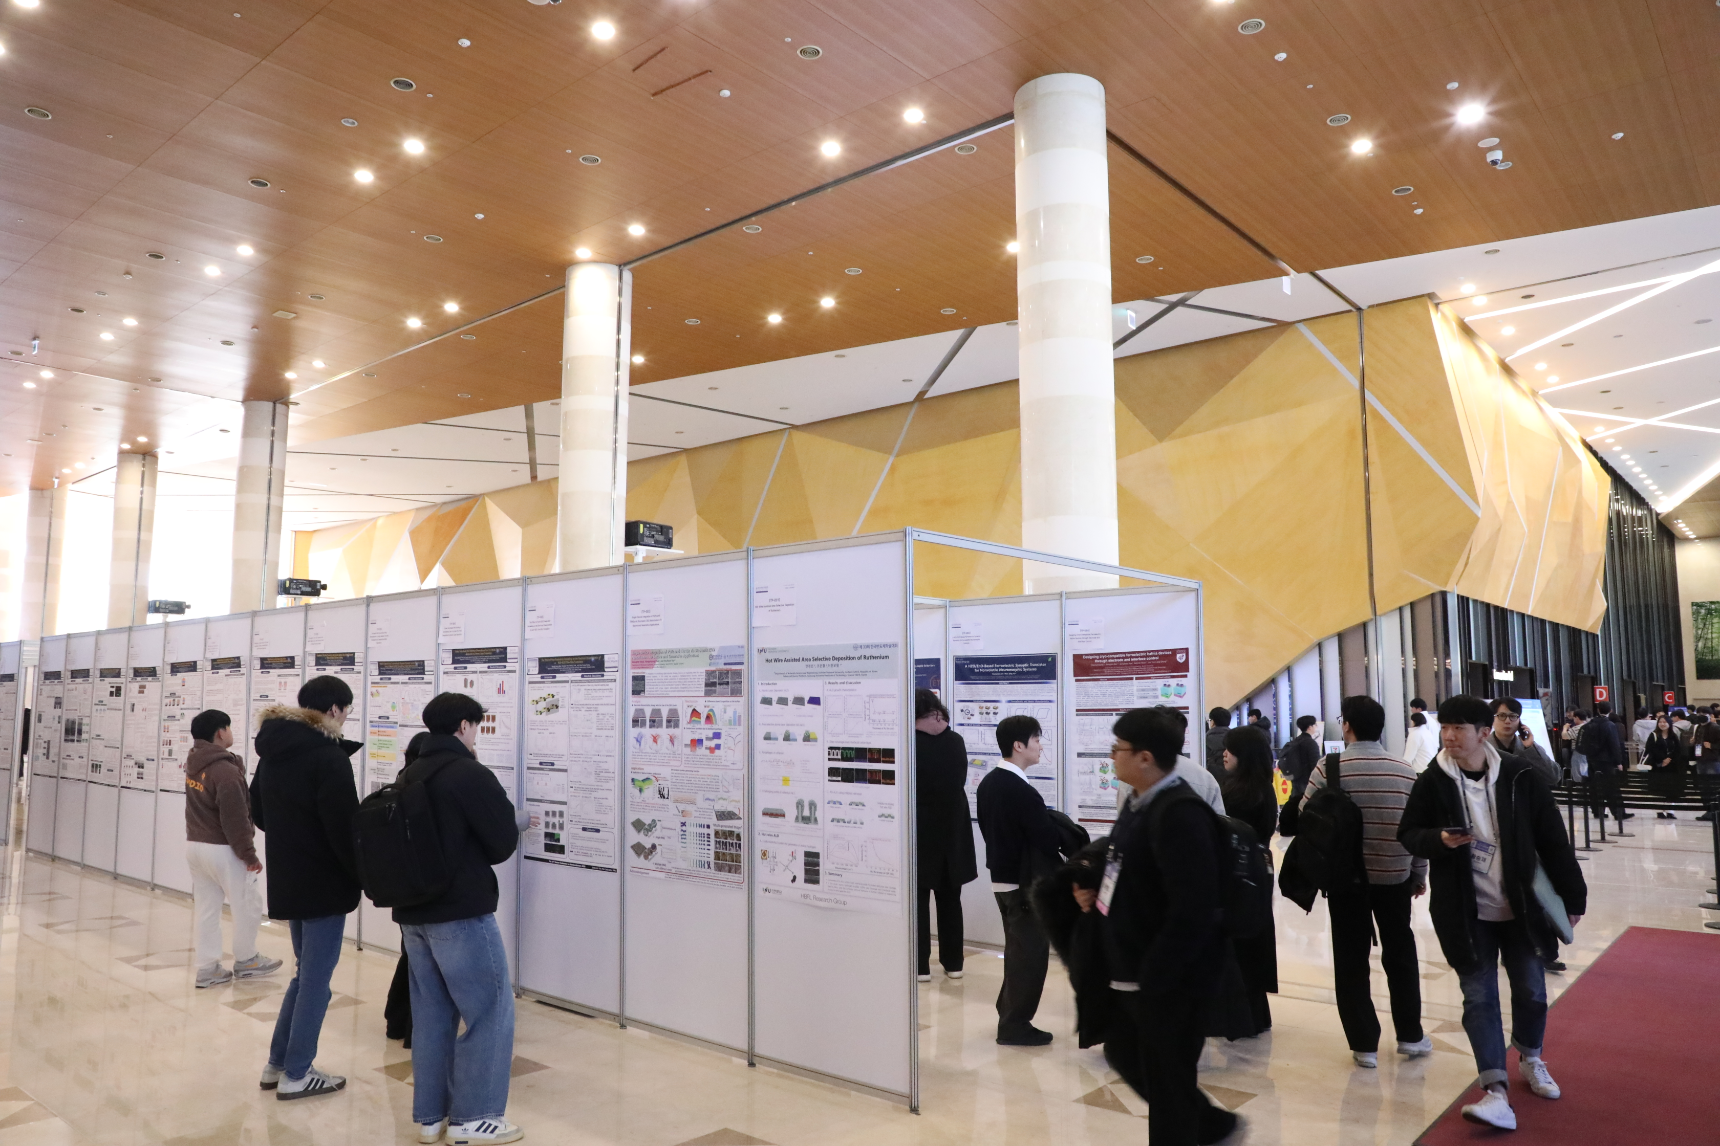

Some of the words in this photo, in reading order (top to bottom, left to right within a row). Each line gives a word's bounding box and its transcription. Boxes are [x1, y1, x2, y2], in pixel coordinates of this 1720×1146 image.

[1596, 689, 1606, 700] D
[1665, 694, 1673, 702] C
[813, 895, 832, 903] Research
